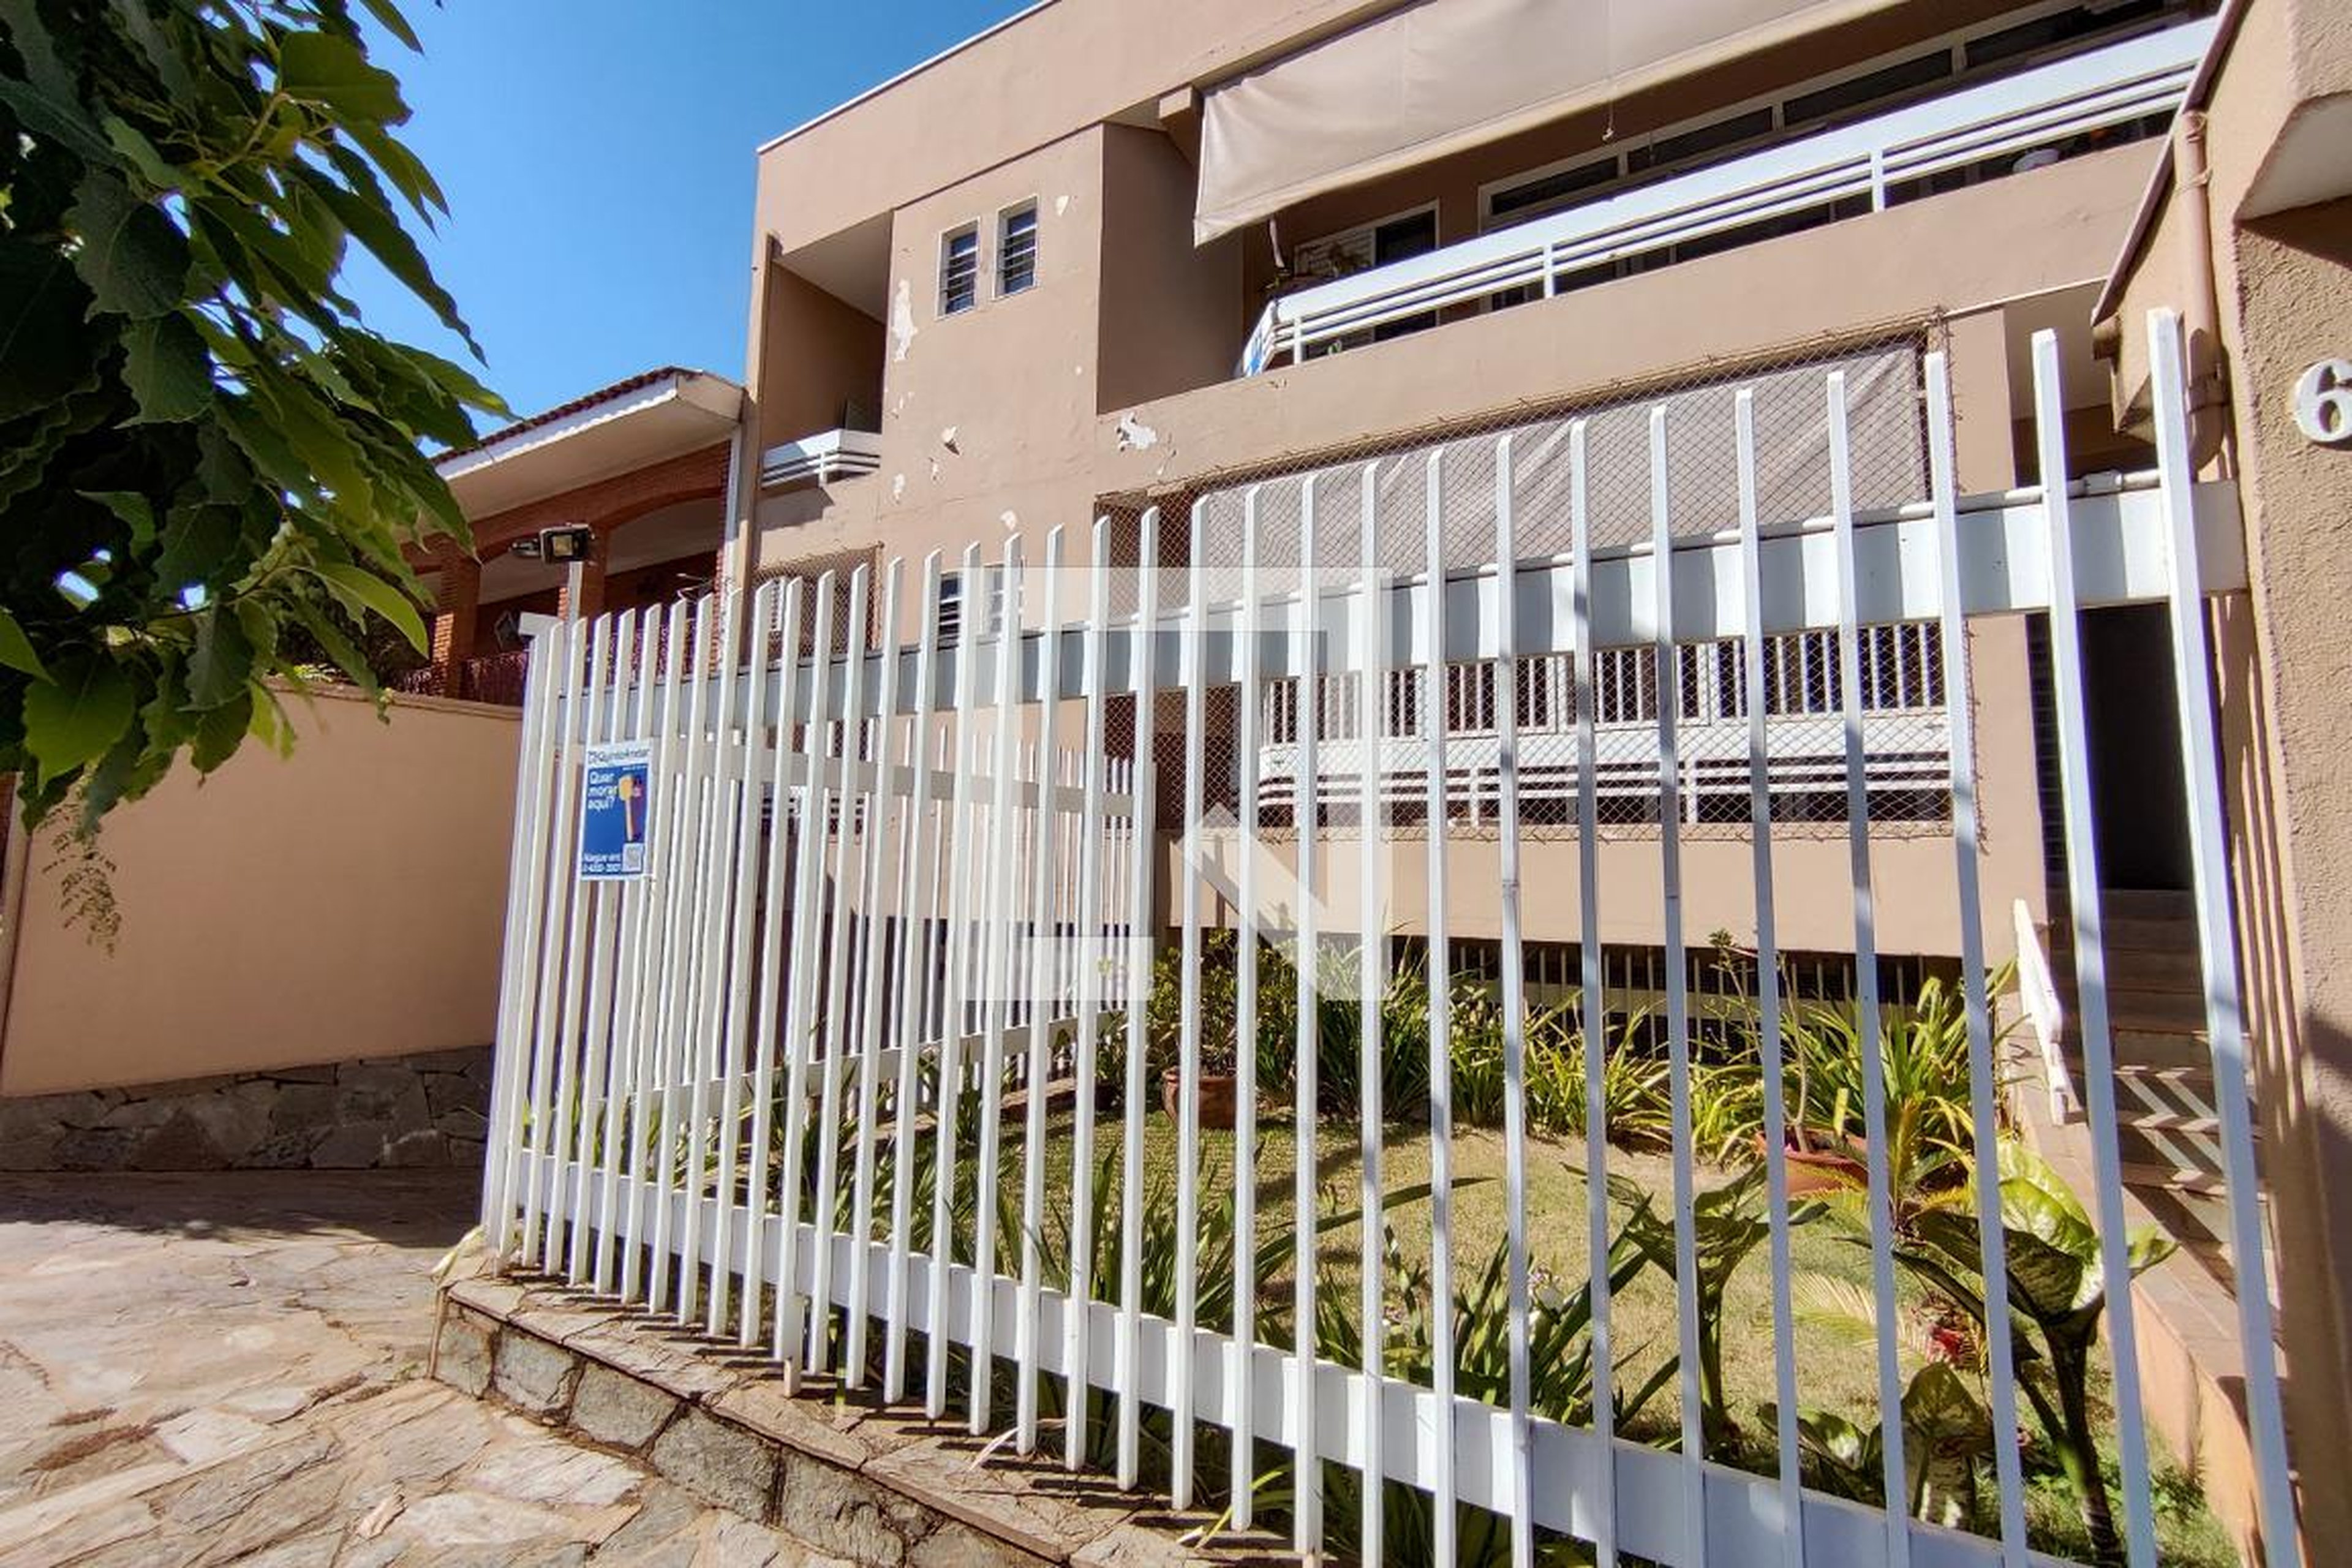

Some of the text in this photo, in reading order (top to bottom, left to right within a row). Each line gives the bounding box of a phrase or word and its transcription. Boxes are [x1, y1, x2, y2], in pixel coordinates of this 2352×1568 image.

[2295, 357, 2352, 442] 6
[589, 771, 615, 784] Quer
[587, 797, 616, 812] aqui?
